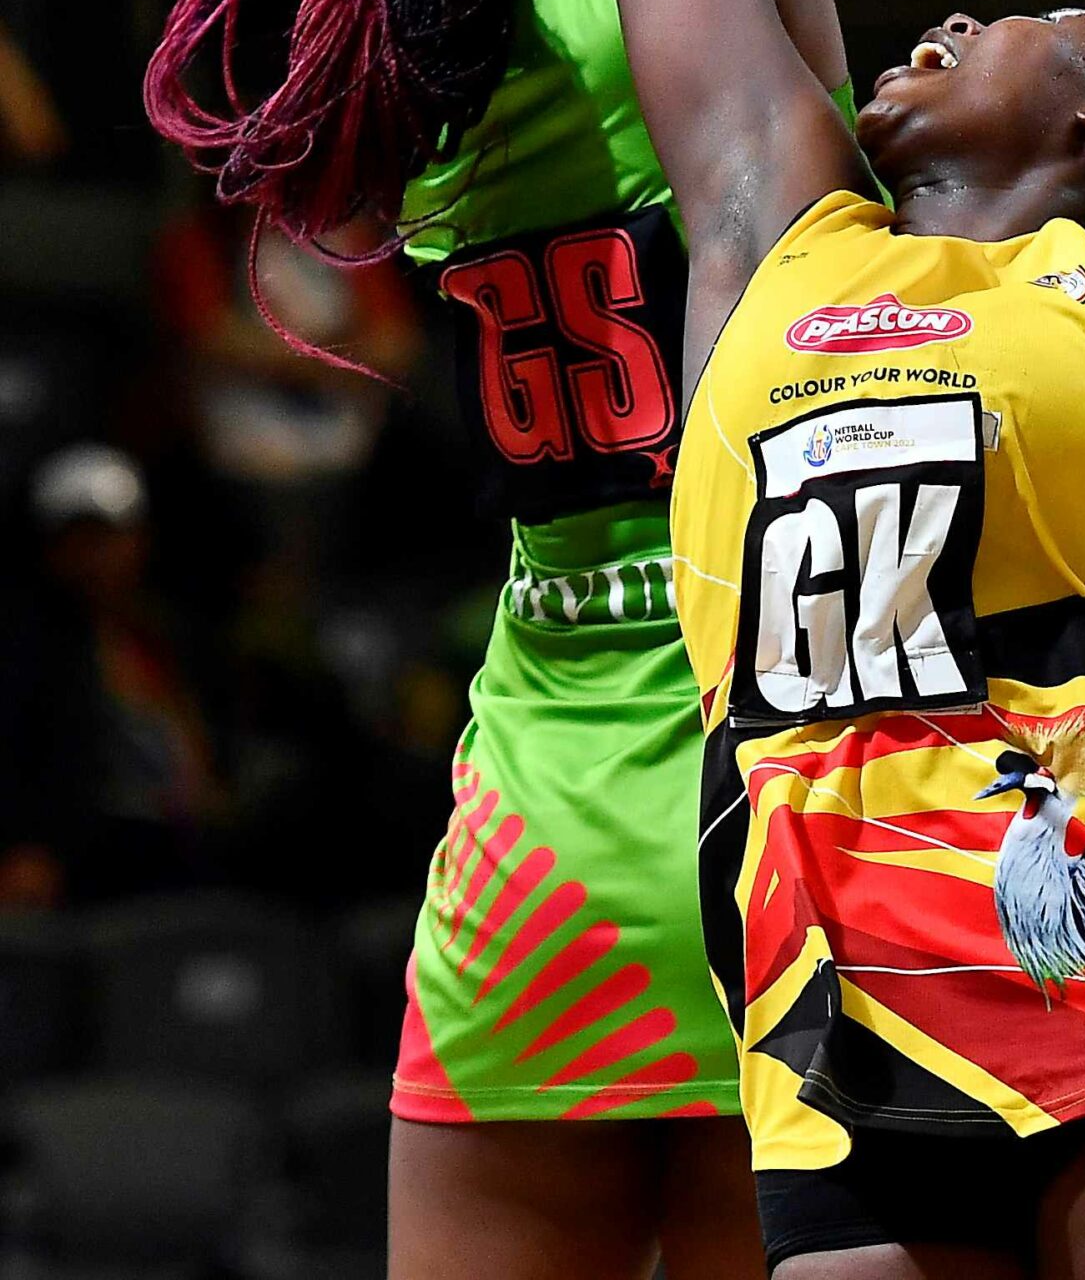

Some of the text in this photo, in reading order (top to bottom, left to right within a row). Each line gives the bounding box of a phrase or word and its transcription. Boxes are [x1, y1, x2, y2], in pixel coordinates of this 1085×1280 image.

[440, 228, 675, 464] GS
[769, 376, 846, 404] COLOUR
[906, 368, 977, 389] WORLD
[834, 423, 875, 436] NETBALL
[835, 431, 895, 444] WORLD CUP
[756, 483, 968, 713] GK
